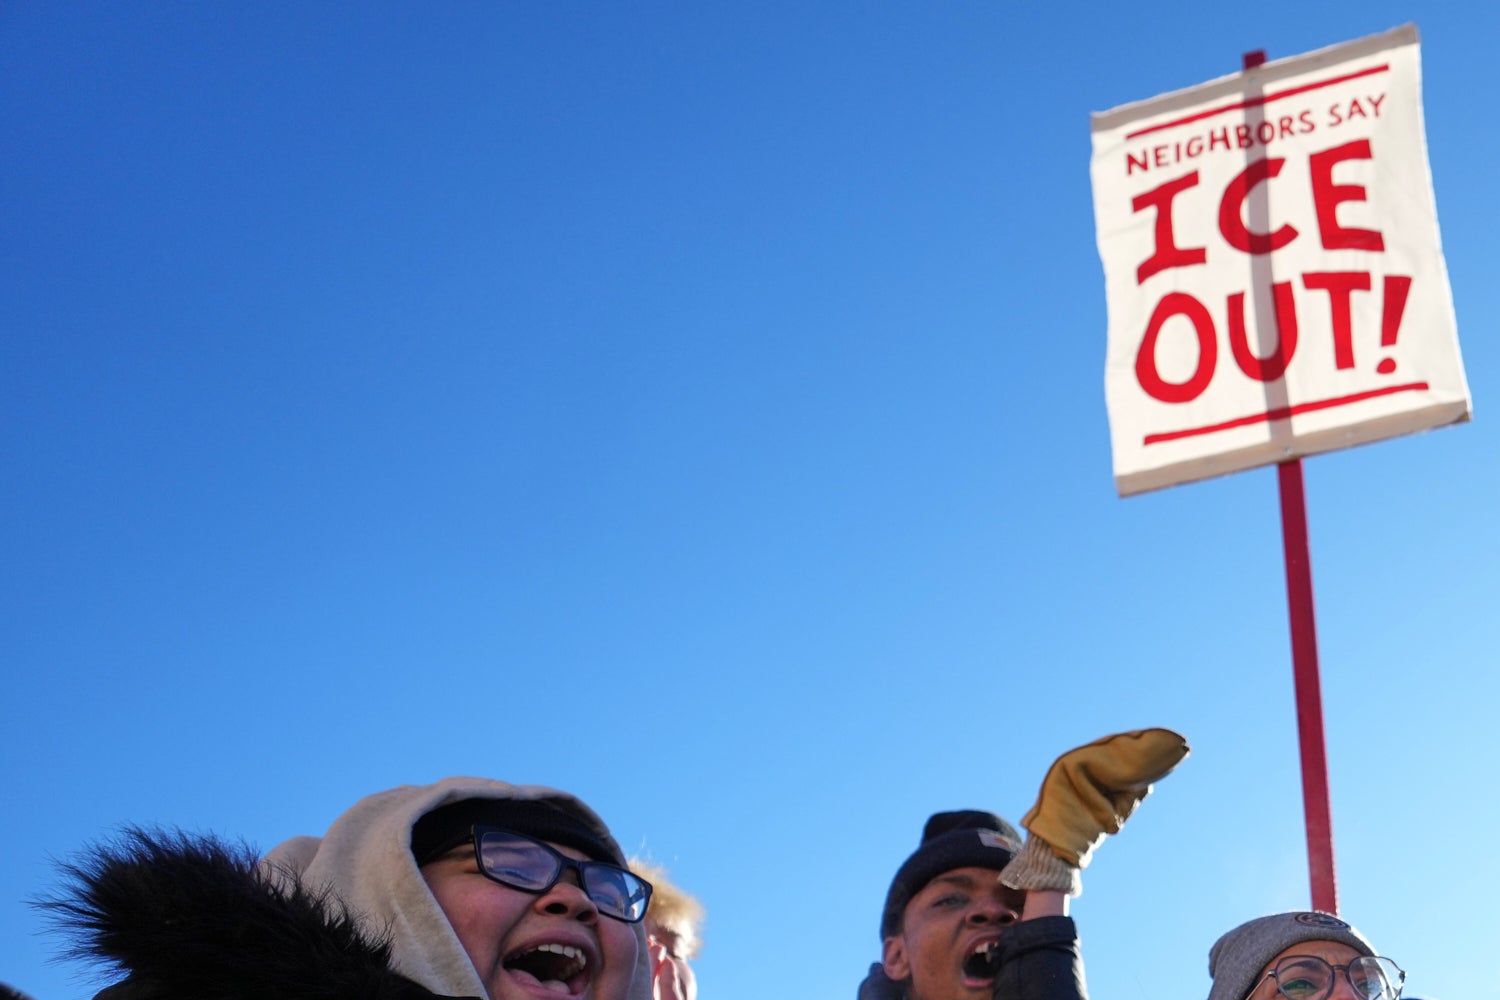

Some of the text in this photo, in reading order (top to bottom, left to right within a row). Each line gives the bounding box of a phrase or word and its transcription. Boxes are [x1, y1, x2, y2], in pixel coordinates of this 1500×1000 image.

[1125, 93, 1387, 176] NEIGHBORS SAY
[1131, 138, 1386, 286] ICE
[1134, 270, 1412, 404] OUT!
